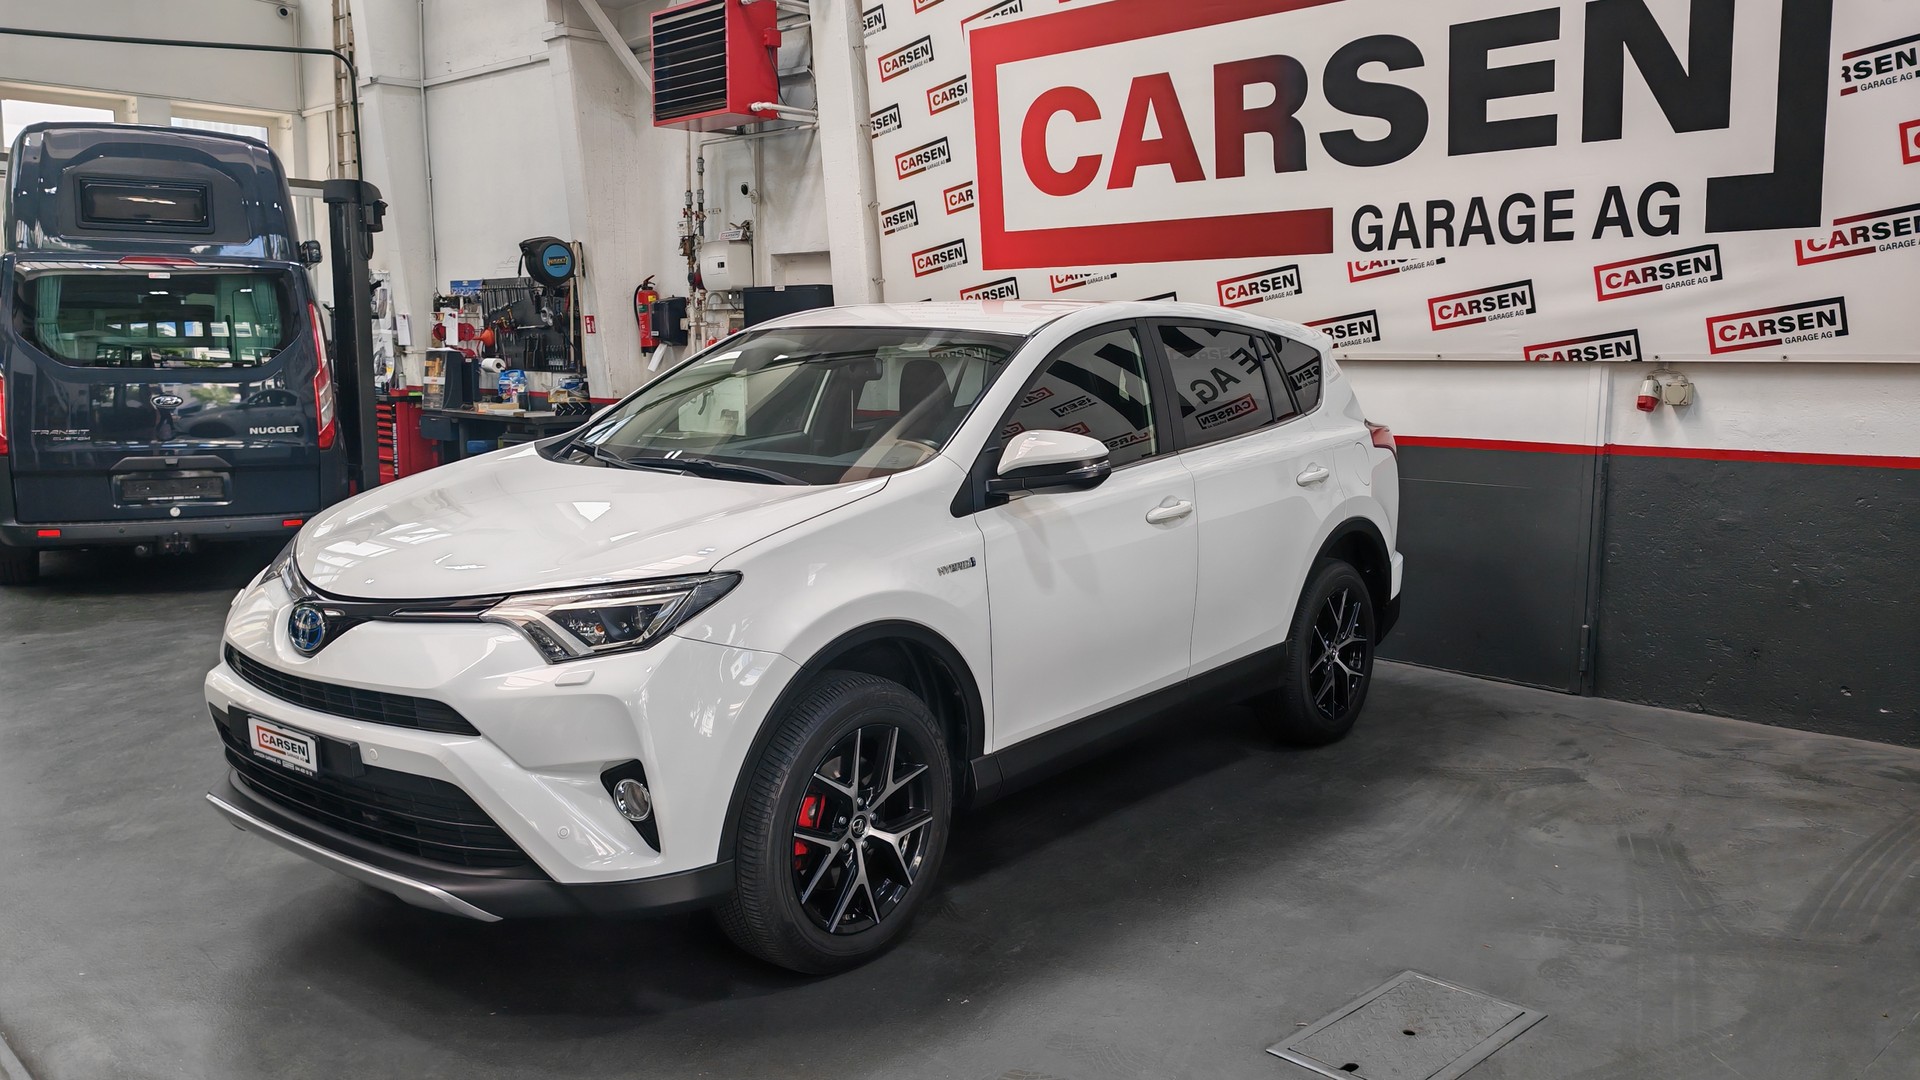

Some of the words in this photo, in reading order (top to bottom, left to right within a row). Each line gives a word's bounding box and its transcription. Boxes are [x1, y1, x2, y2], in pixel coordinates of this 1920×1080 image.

[884, 44, 929, 73] CARSEN
[1860, 76, 1897, 91] GARAGE
[1900, 72, 1913, 82] AG
[1021, 0, 1735, 197] CARSEN
[901, 145, 946, 172] CARSEN
[949, 189, 974, 206] CAR
[1351, 189, 1575, 252] GARAGE
[1592, 181, 1680, 239] AG
[1878, 239, 1916, 252] GARAGE
[917, 246, 963, 269] CARSEN
[1401, 261, 1426, 272] GARAGE
[1087, 277, 1103, 285] GARAGE
[1604, 255, 1712, 289] CARSEN
[1224, 273, 1296, 301] CARSEN
[1665, 278, 1696, 290] GARAGE
[1697, 276, 1709, 284] AG
[1264, 292, 1285, 301] GARAGE
[1437, 290, 1528, 320] CARSEN
[1487, 311, 1514, 322] GARAGE
[1514, 309, 1525, 317] AG
[1719, 309, 1837, 342] CARSEN
[1339, 338, 1363, 348] GARAGE
[1785, 332, 1820, 344] GARAGE
[1820, 331, 1833, 339] AG
[249, 425, 300, 435] NUGGET
[261, 733, 306, 757] CARSEN
